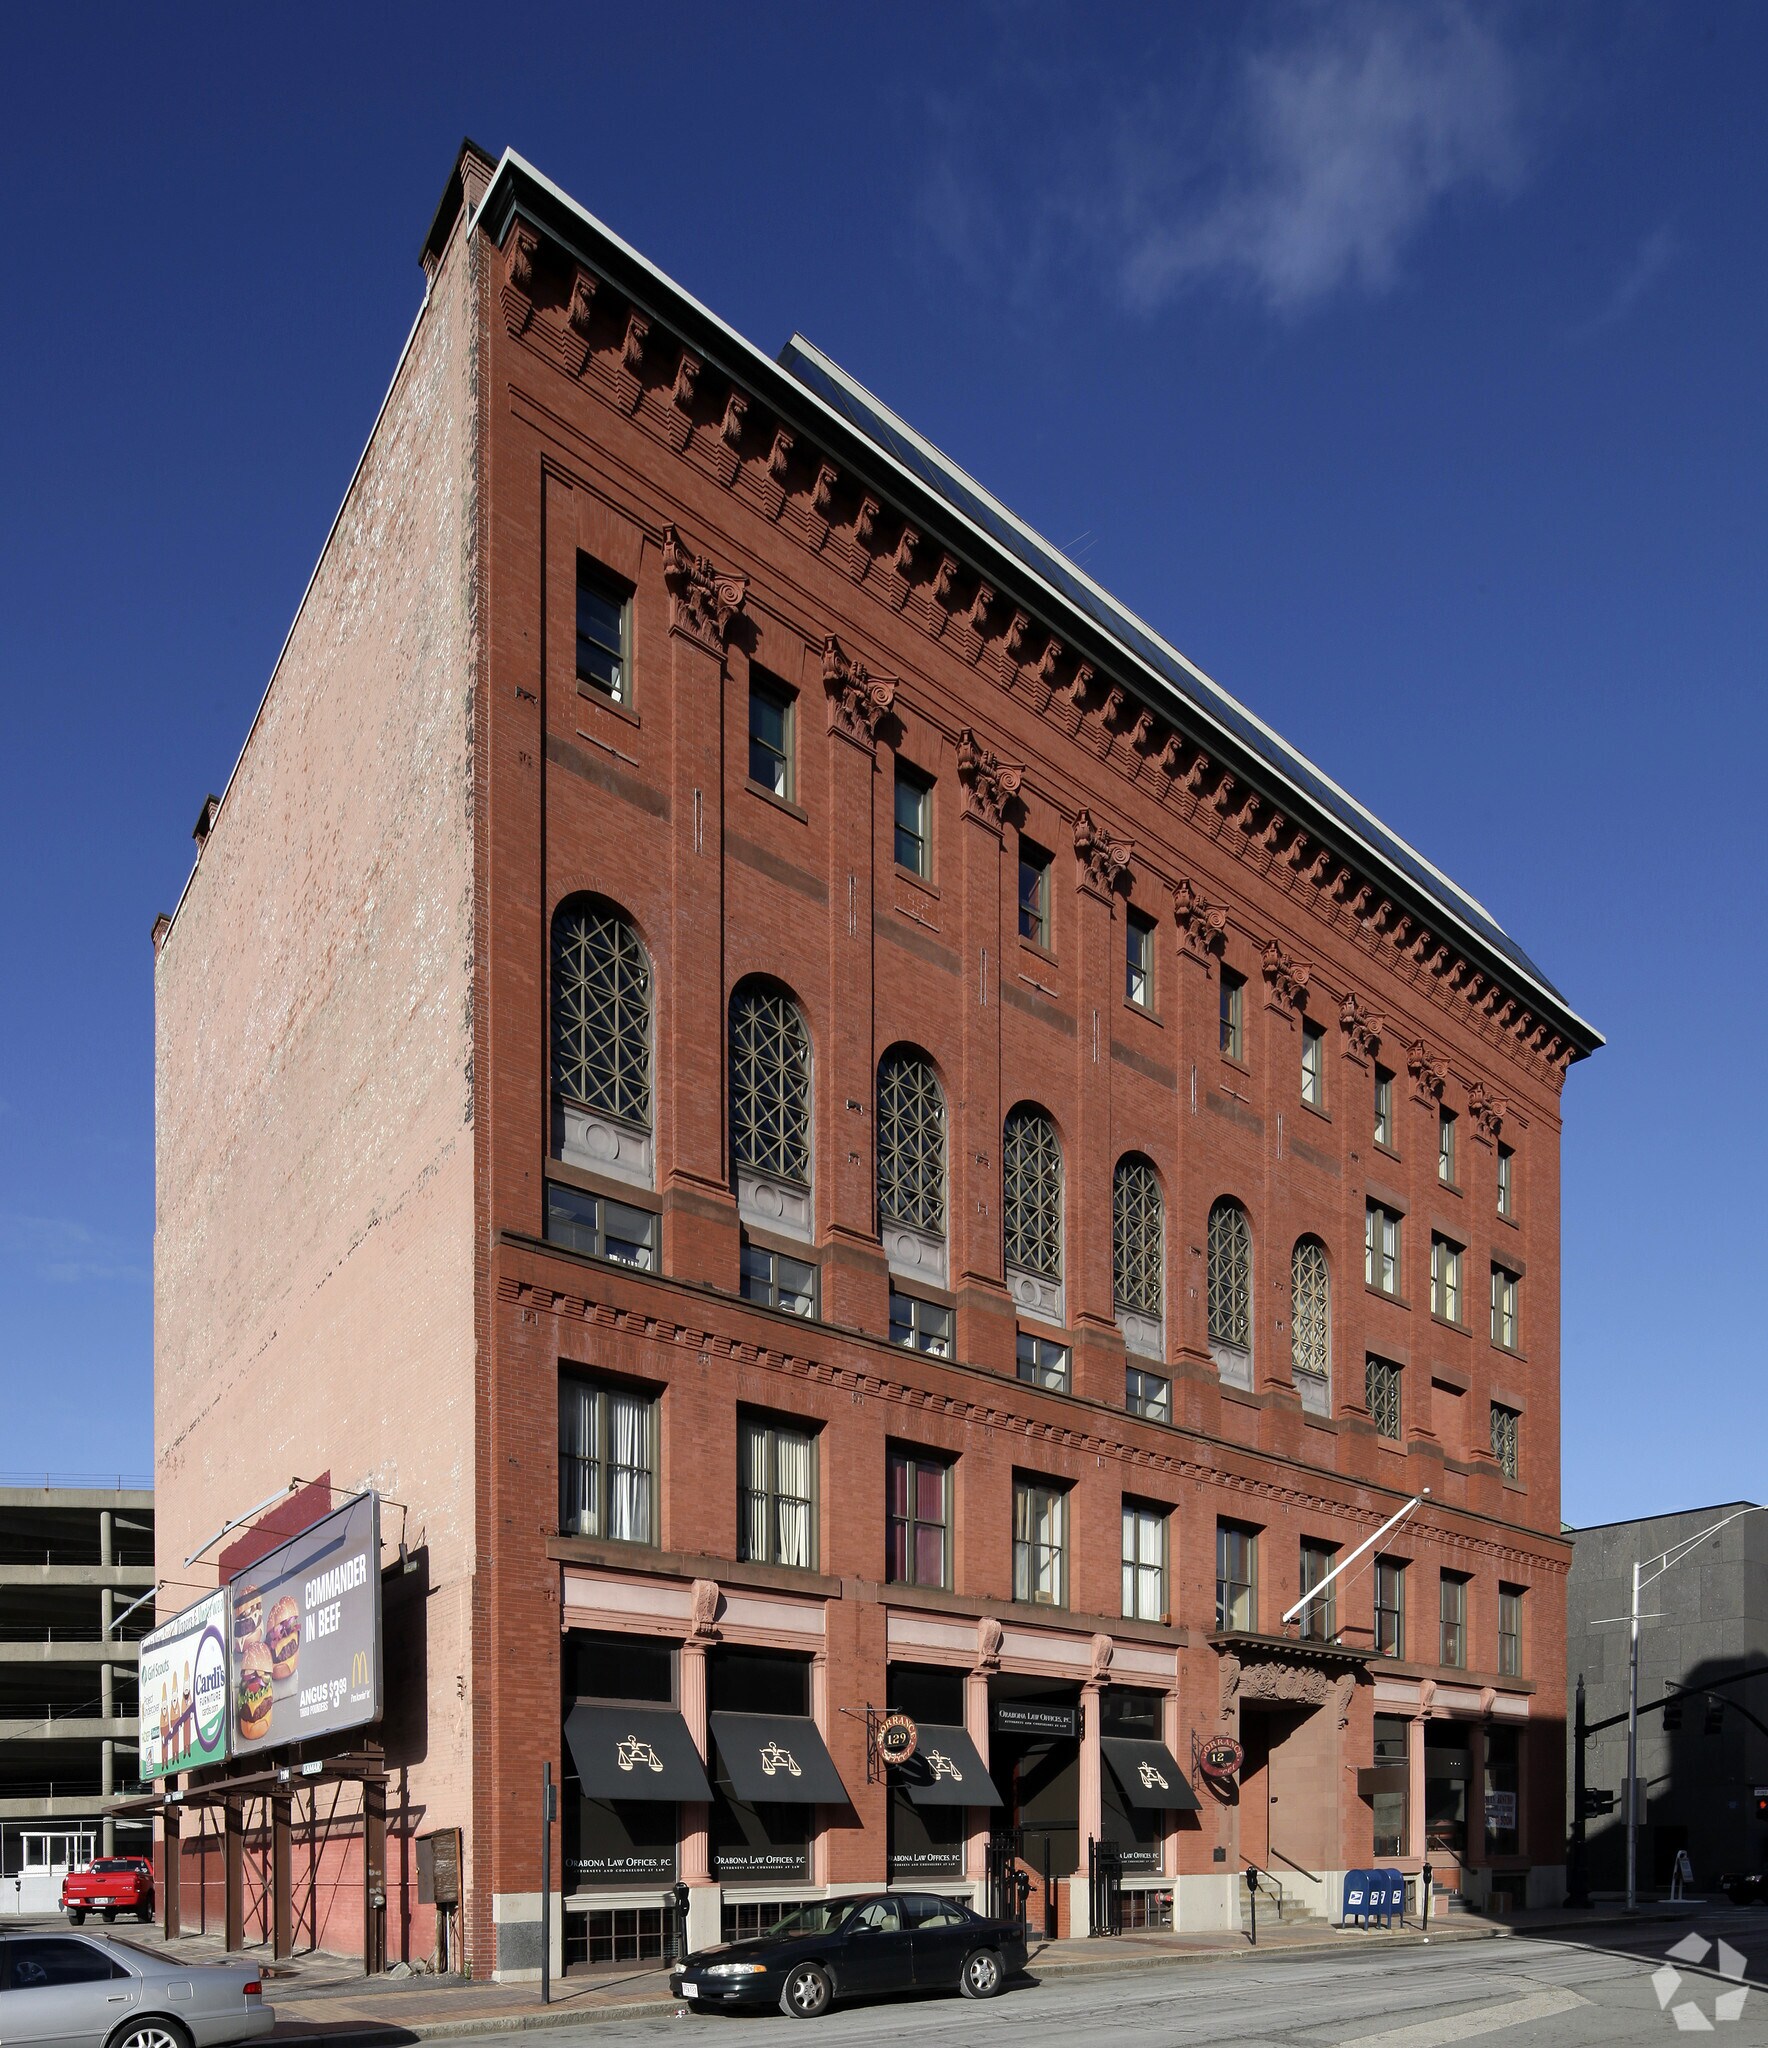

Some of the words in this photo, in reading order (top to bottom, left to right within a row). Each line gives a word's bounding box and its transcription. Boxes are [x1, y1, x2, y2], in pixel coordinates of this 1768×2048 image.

[305, 1554, 366, 1610] COMMANDER
[306, 1613, 315, 1643] IN
[318, 1601, 340, 1638] BEEF
[196, 1664, 225, 1695] Cardi's
[300, 1683, 328, 1707] ANGUS
[877, 1716, 916, 1744] DORRANCE
[888, 1732, 906, 1745] 129
[607, 1857, 624, 1867] LAW
[713, 1855, 747, 1865] ORABONA
[749, 1855, 765, 1864] LAW
[914, 1853, 927, 1861] LAW
